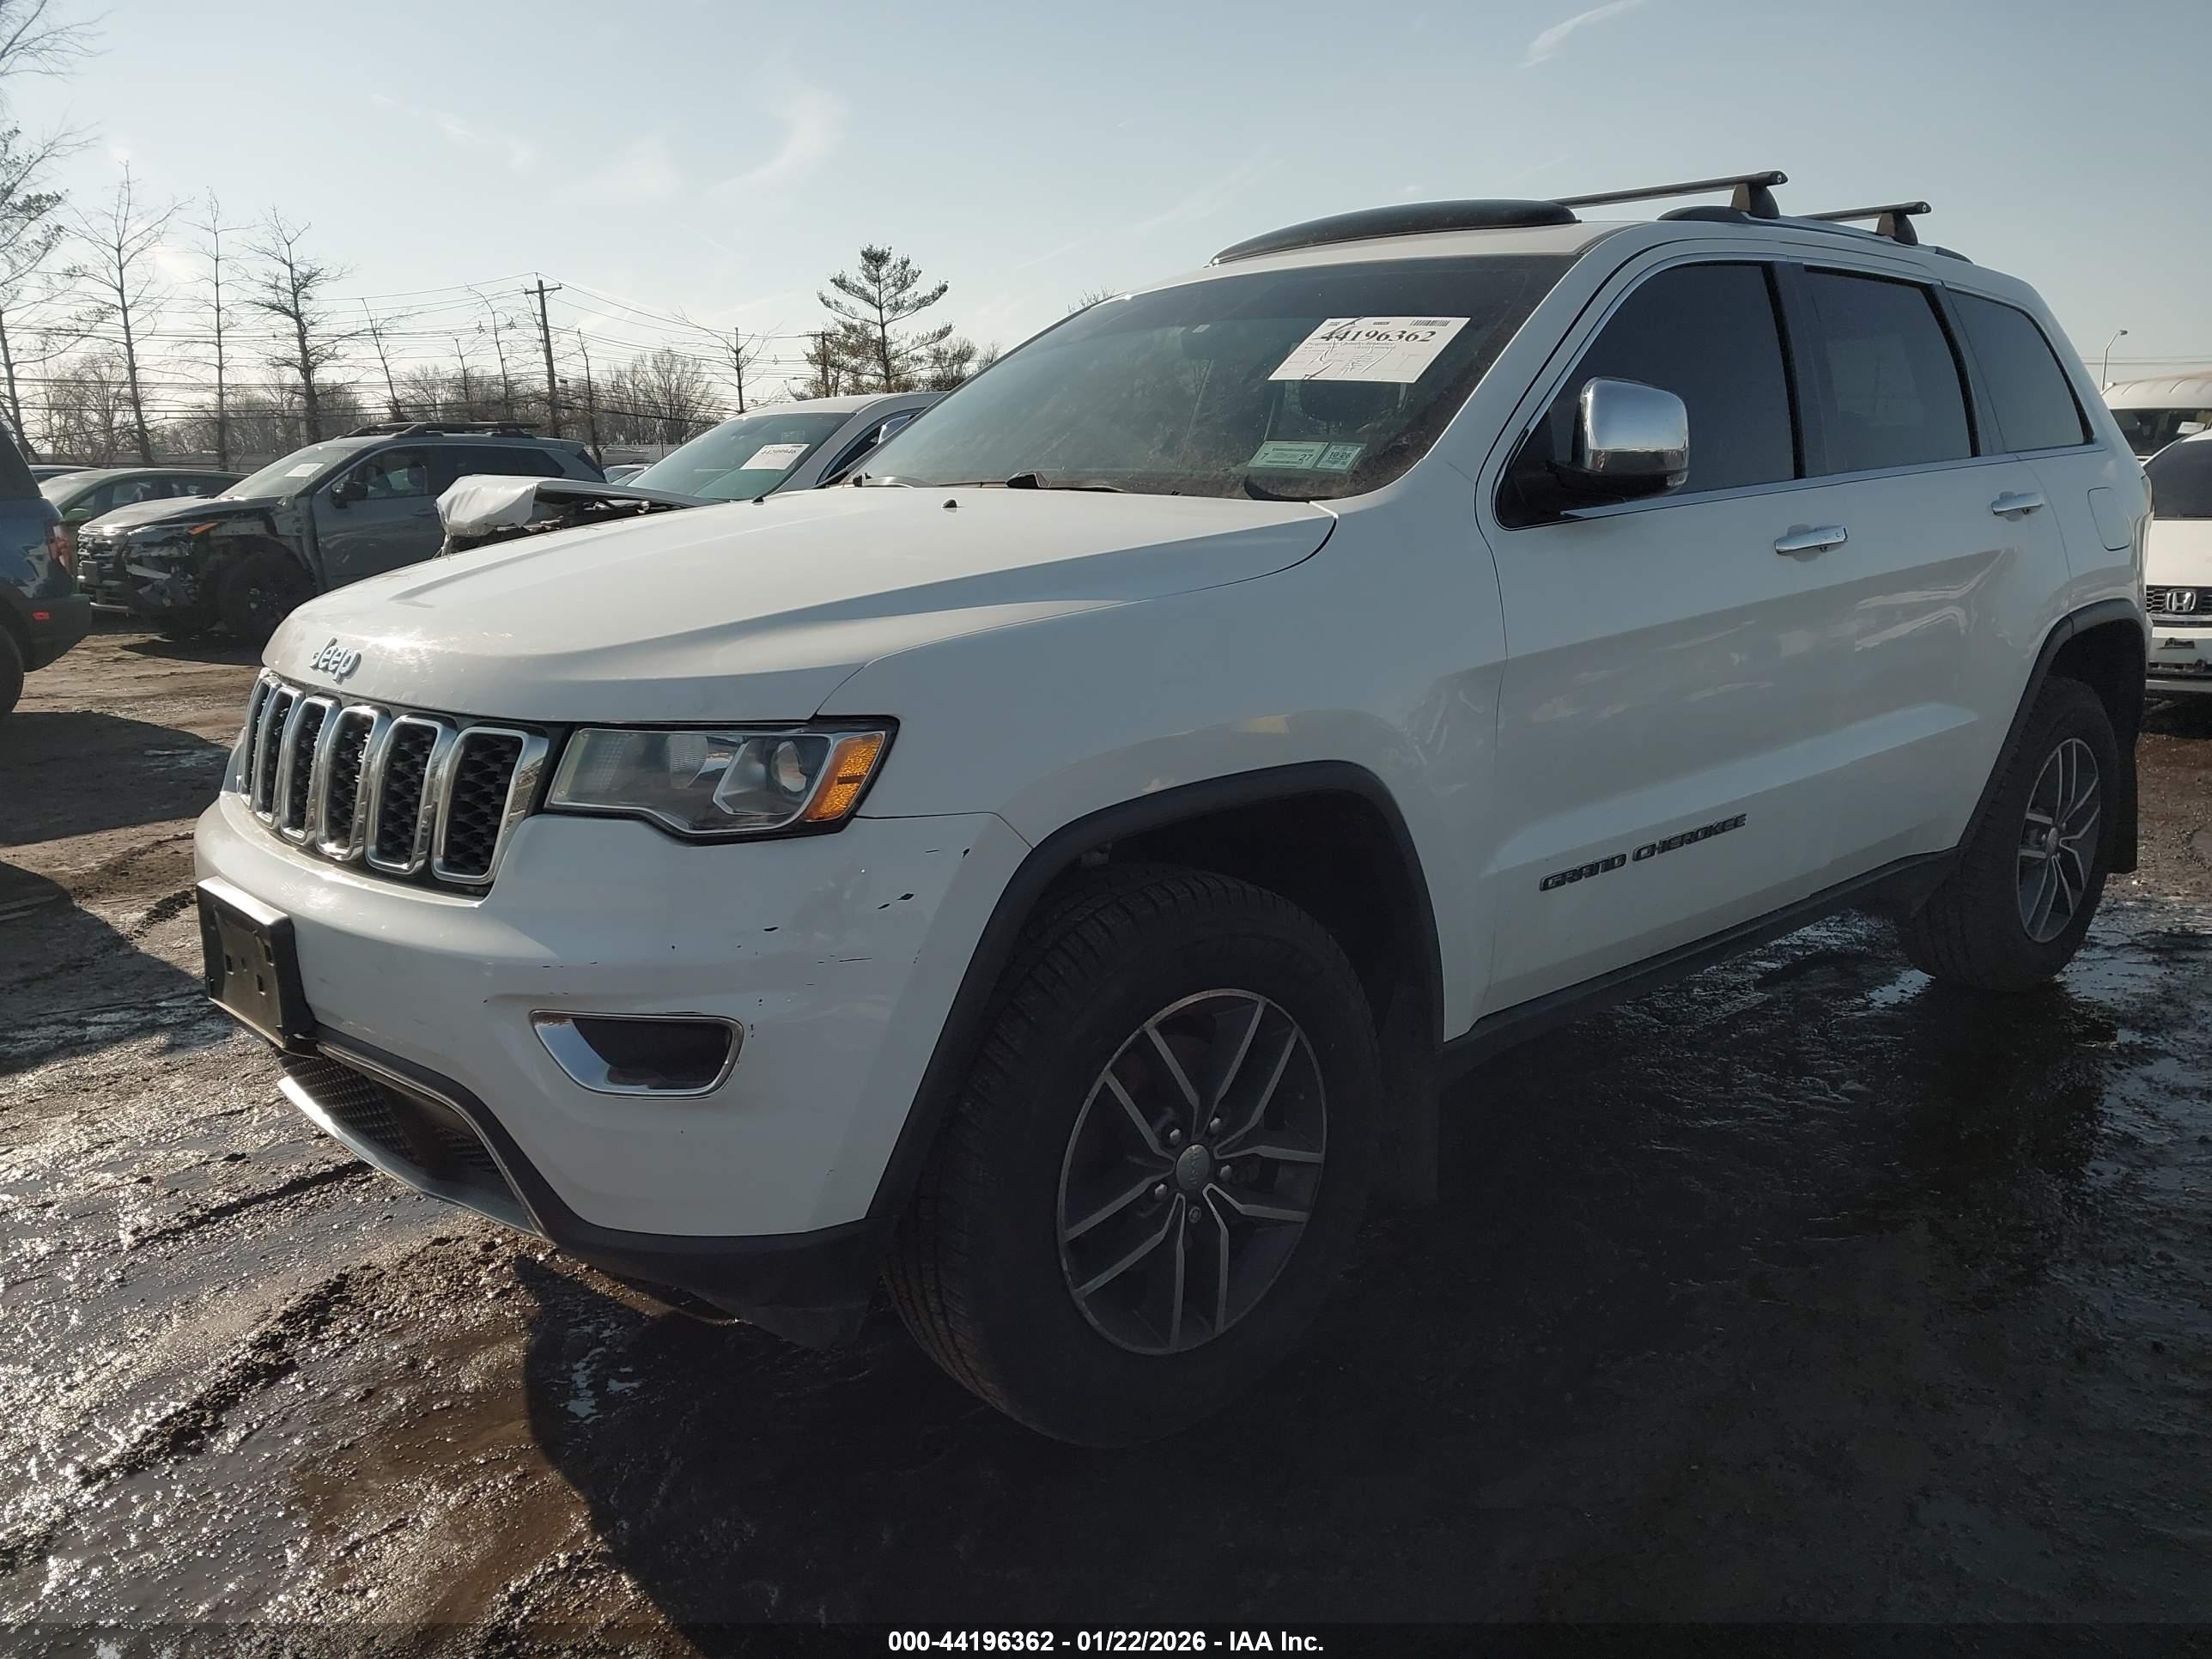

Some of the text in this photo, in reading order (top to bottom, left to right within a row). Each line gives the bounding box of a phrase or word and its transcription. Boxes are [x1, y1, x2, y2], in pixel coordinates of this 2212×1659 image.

[1319, 330, 1437, 343] 44196362
[309, 637, 362, 685] Jeep
[1539, 813, 1747, 892] GRAND CHEROKEE
